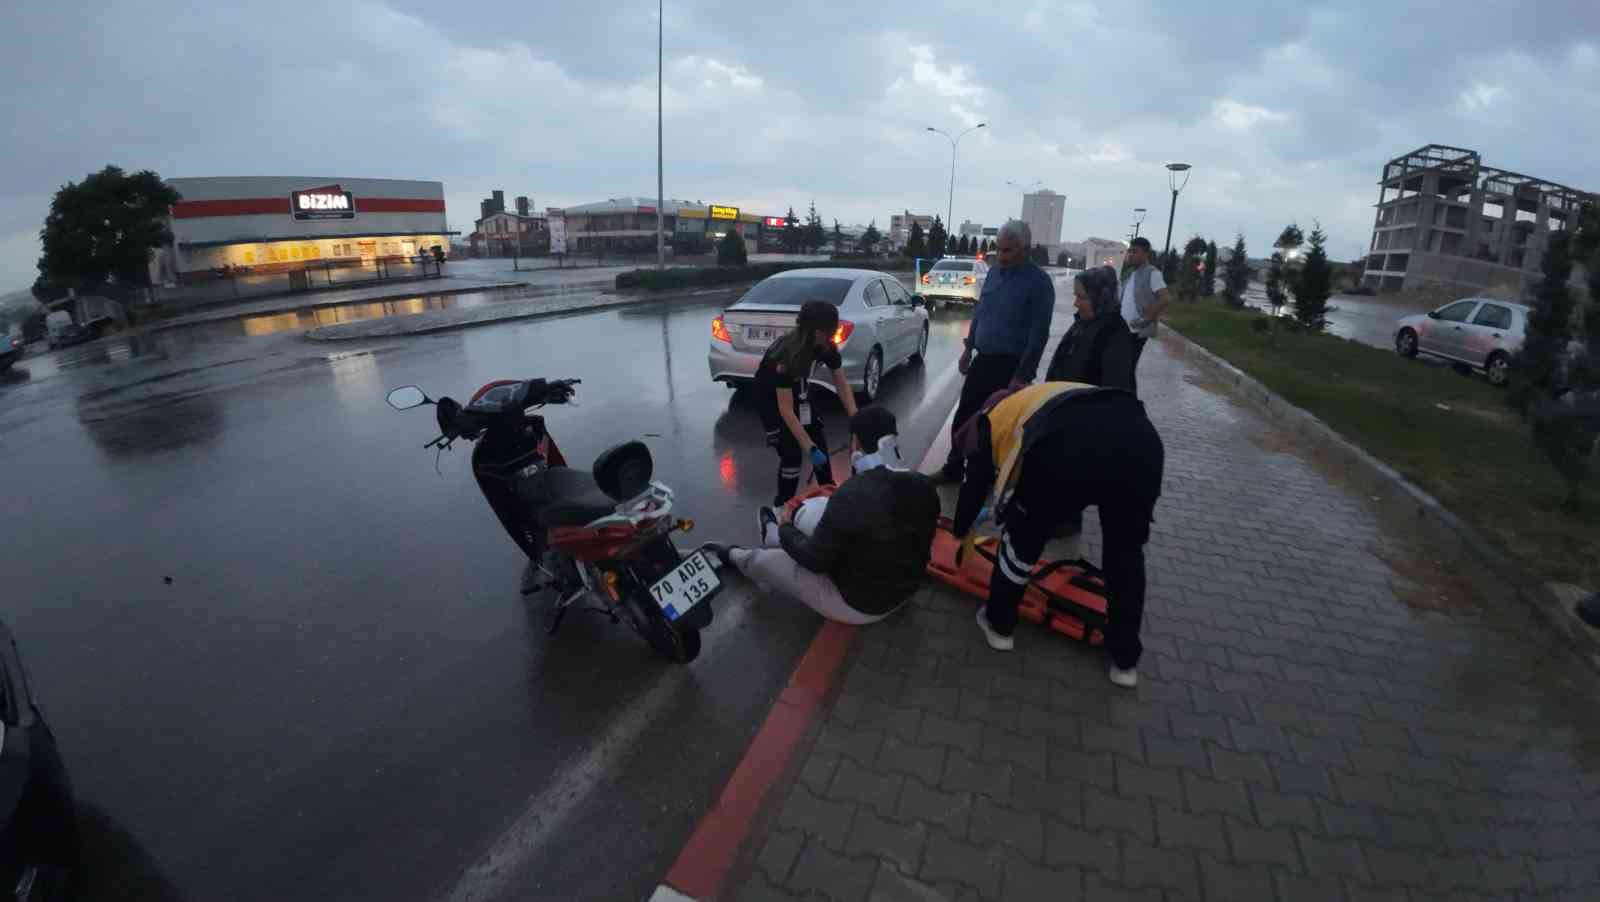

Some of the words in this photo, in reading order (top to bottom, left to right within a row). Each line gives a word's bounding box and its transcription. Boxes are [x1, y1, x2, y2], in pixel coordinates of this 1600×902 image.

[652, 580, 674, 602] 70
[677, 555, 705, 584] ADE
[682, 578, 709, 603] 135
